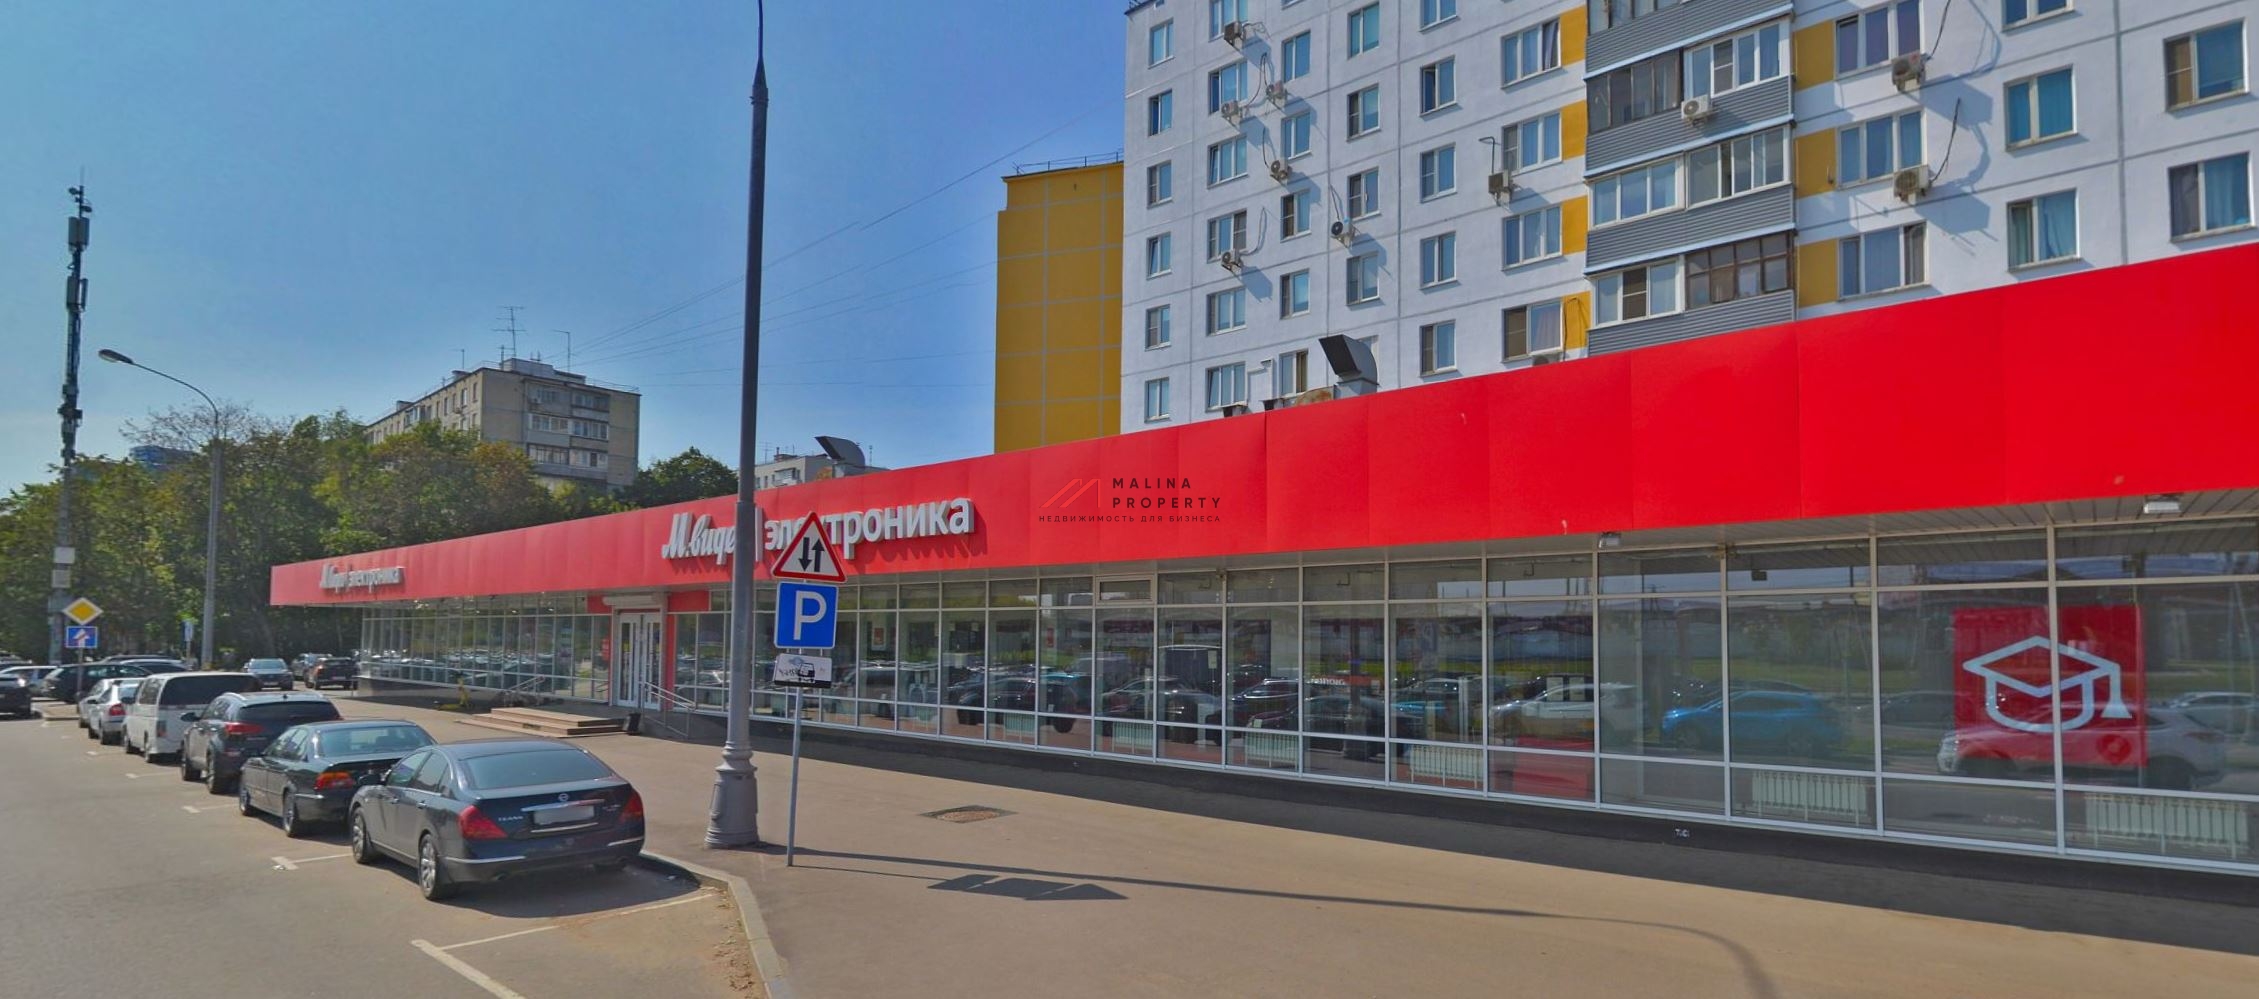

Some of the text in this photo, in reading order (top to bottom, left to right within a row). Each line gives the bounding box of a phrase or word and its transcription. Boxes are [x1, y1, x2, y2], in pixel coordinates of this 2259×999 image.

[661, 497, 972, 564] М.виде элтроника
[793, 590, 826, 640] P
